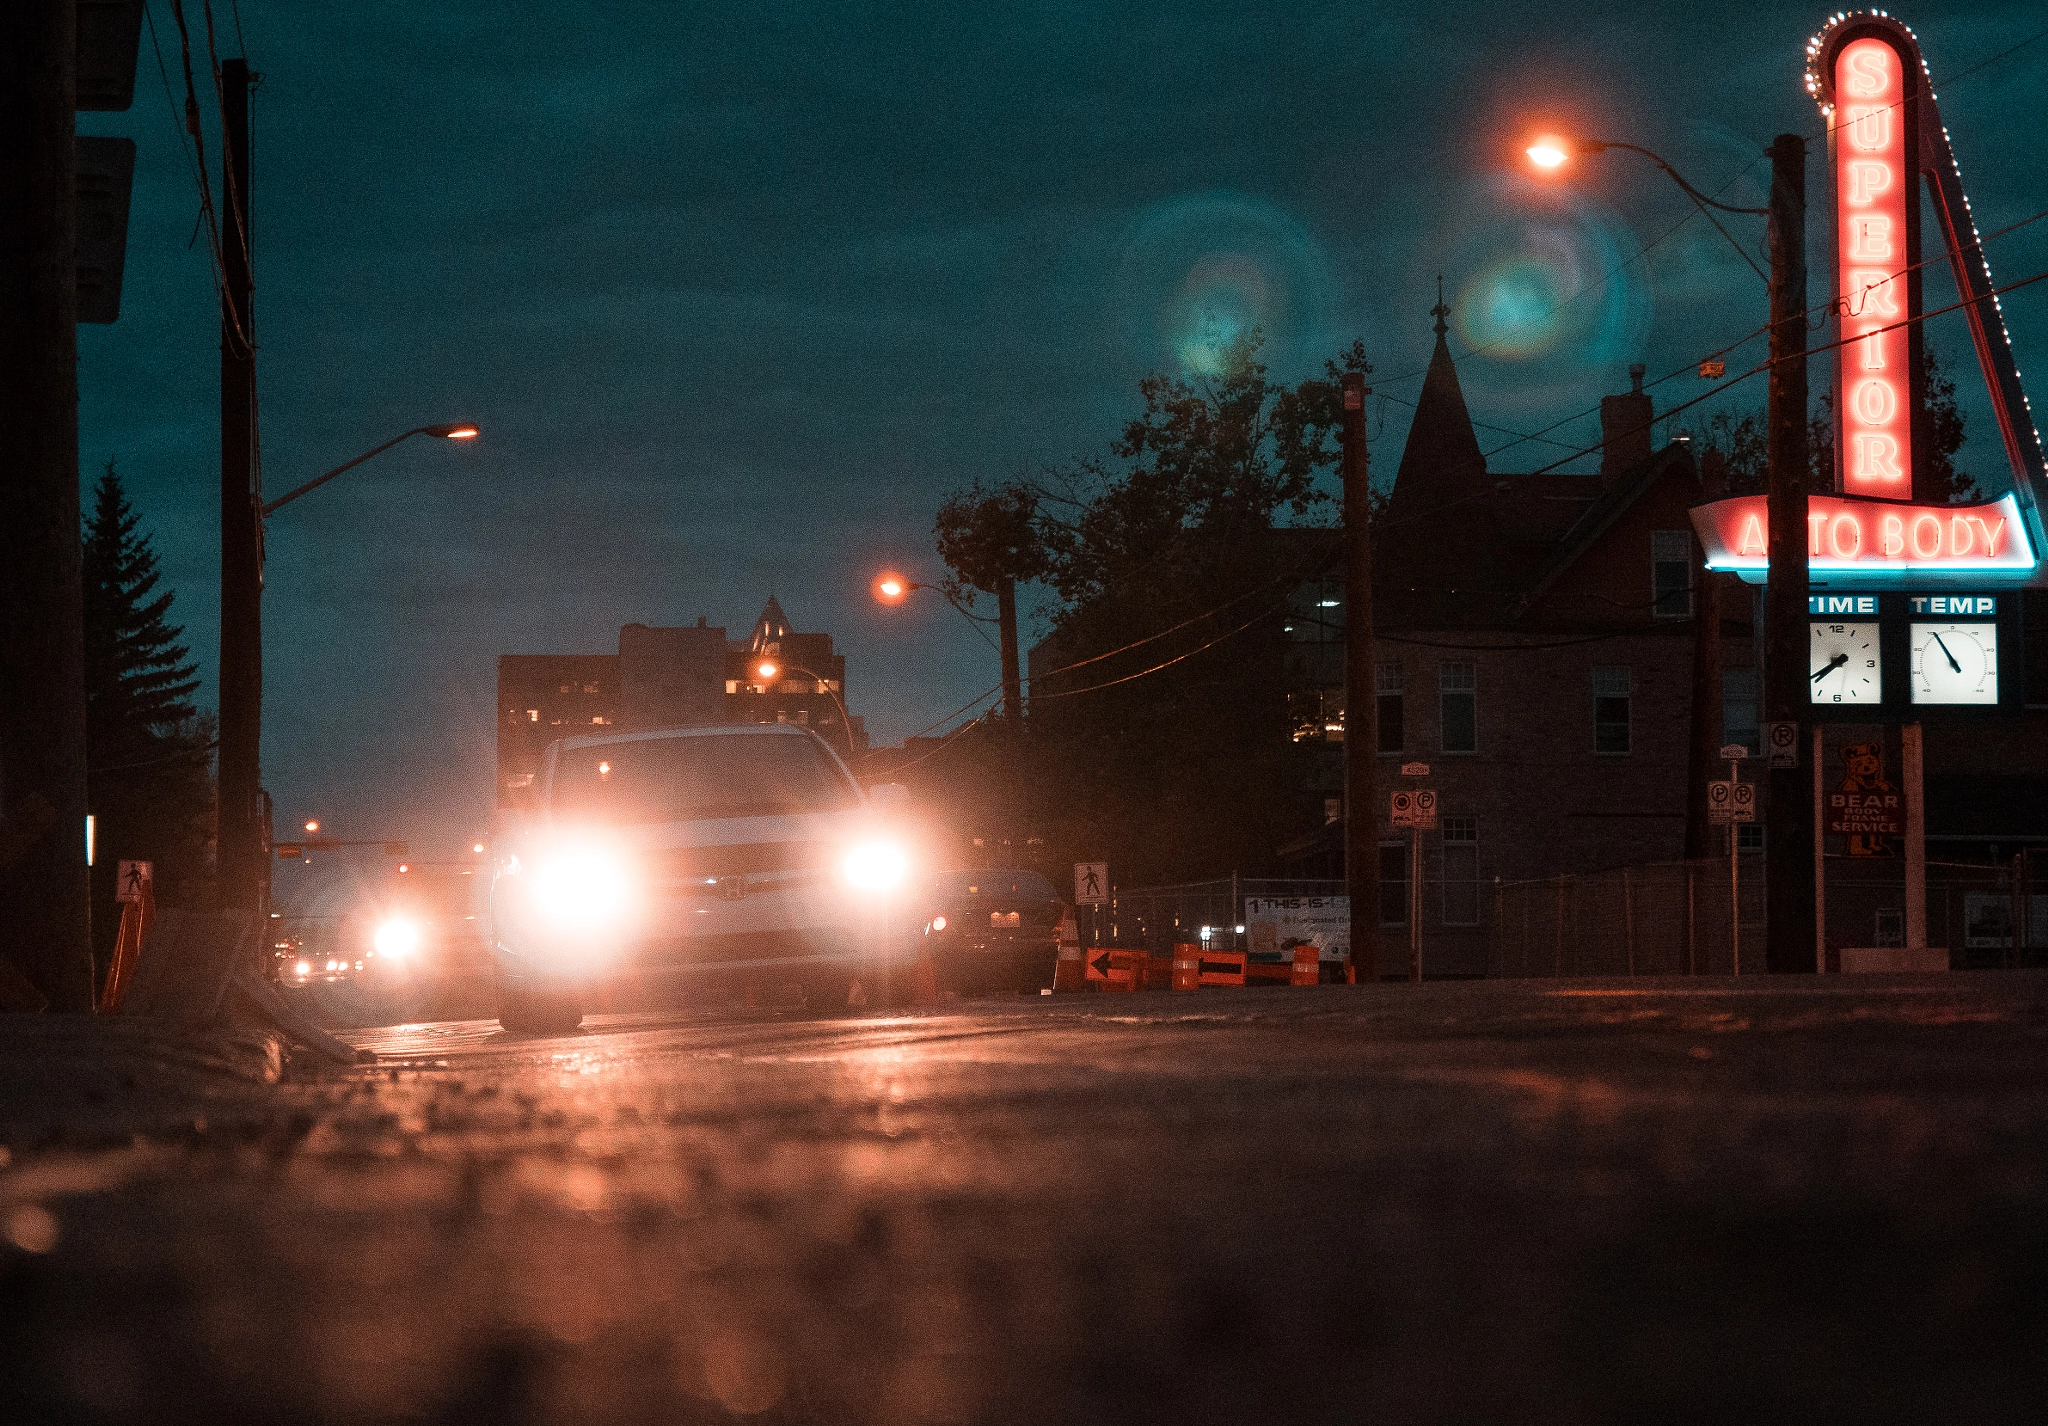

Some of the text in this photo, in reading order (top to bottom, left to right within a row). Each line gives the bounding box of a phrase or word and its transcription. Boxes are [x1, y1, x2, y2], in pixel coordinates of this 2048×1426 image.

[1849, 50, 1903, 478] SUPERIOR
[1739, 513, 2006, 559] ATO BODY
[1828, 624, 1845, 634] 12
[1866, 659, 1876, 668] 3
[1832, 694, 1842, 702] 6
[1831, 794, 1899, 808] BEAR
[1832, 821, 1899, 832] SERVICE
